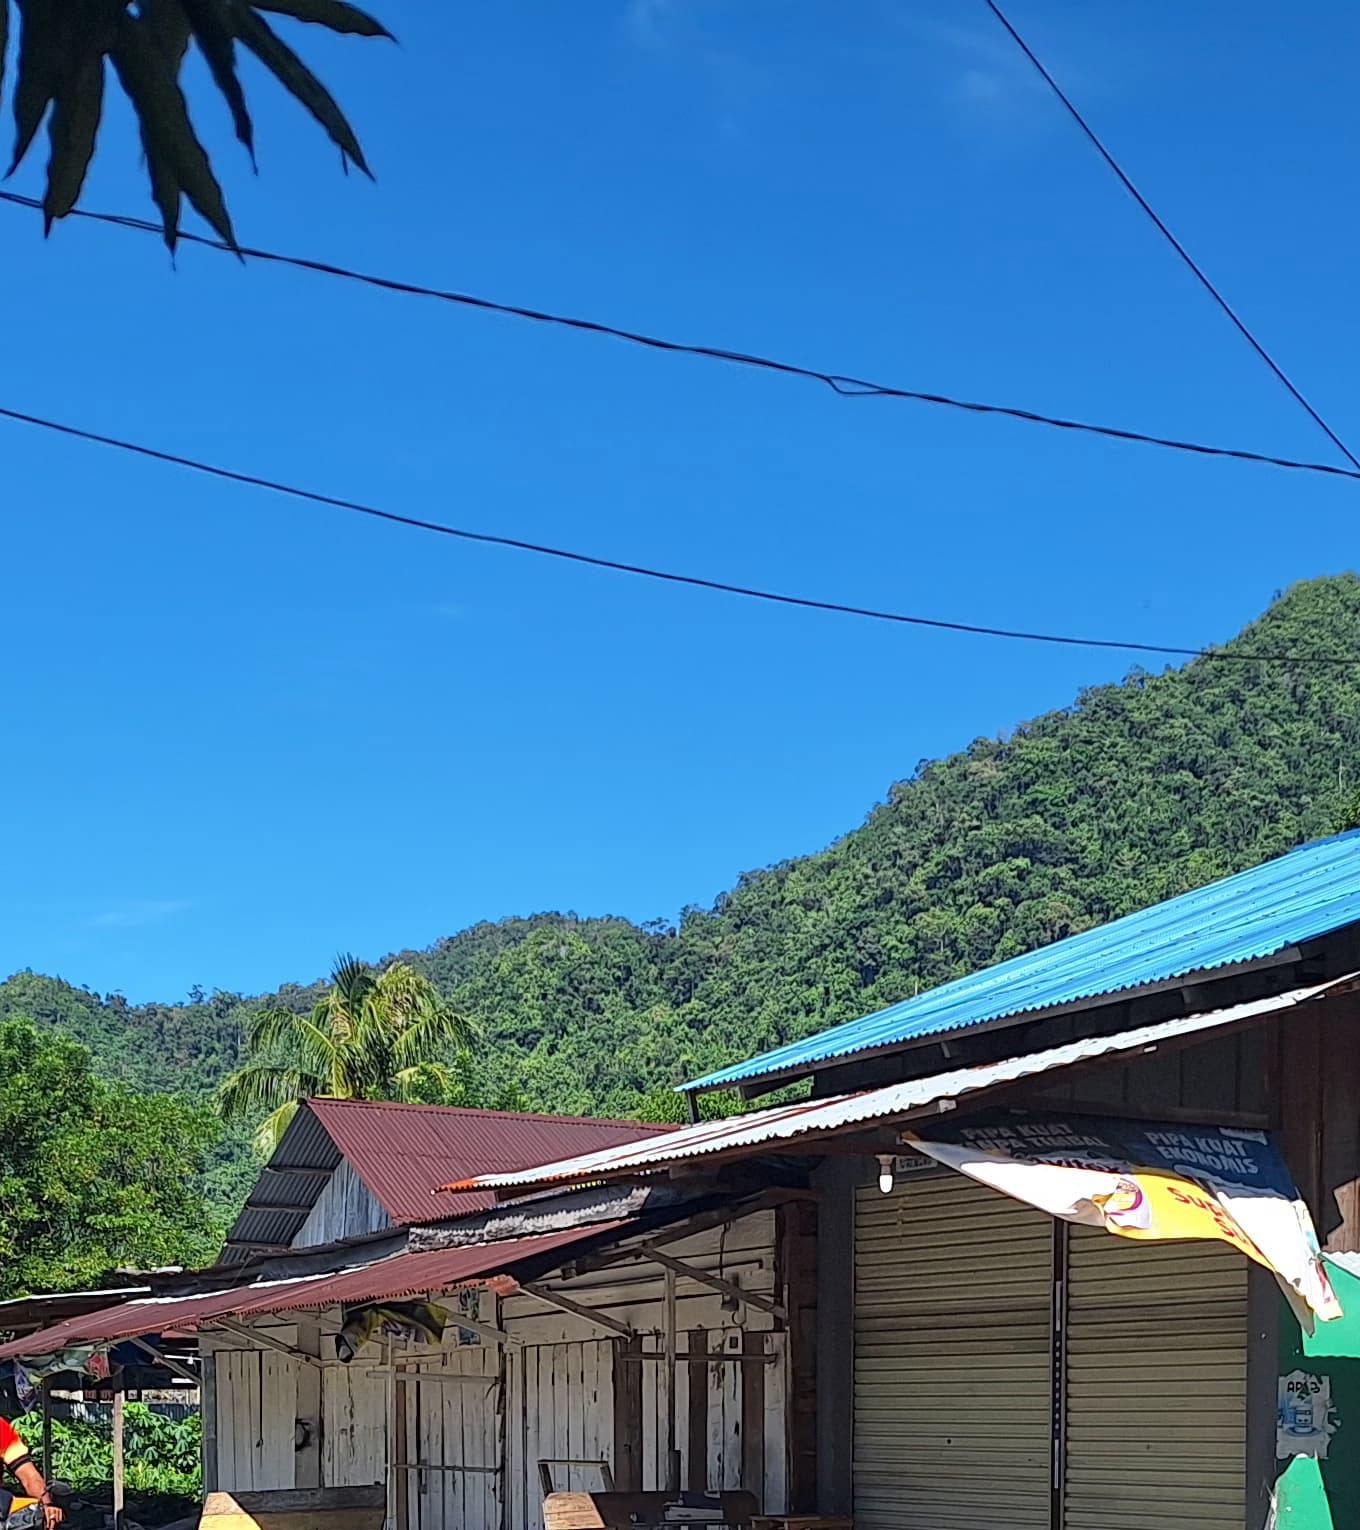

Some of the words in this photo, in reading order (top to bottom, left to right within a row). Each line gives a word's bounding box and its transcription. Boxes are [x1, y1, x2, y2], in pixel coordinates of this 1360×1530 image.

[1143, 1131, 1196, 1150] PIPA
[1194, 1137, 1247, 1157] KUAT
[1156, 1146, 1259, 1175] EKONOMIS
